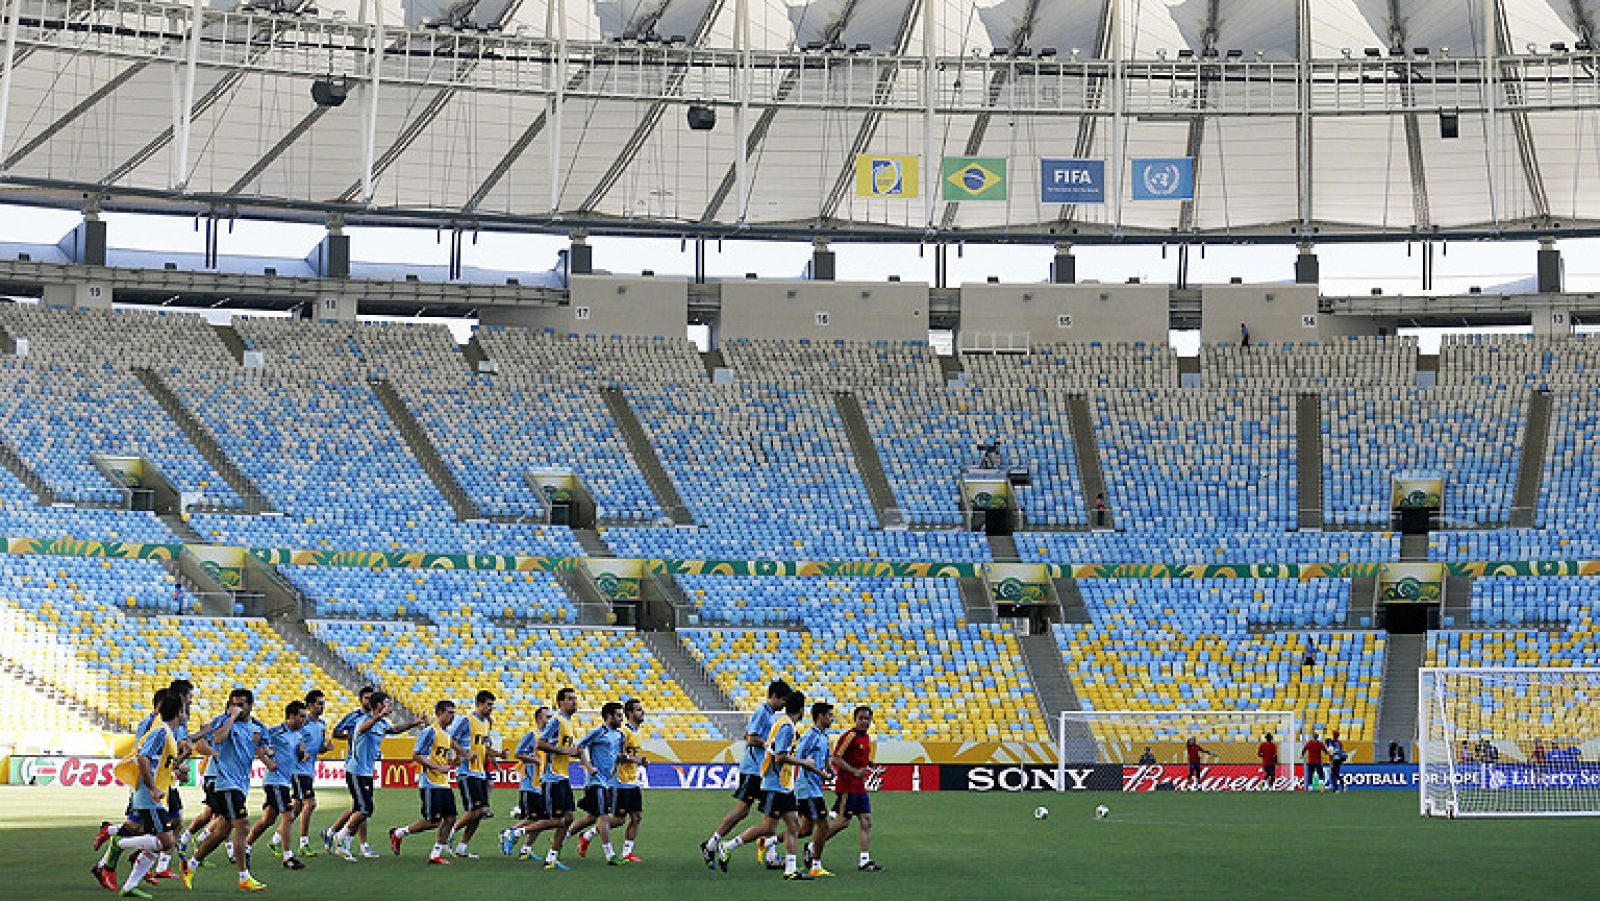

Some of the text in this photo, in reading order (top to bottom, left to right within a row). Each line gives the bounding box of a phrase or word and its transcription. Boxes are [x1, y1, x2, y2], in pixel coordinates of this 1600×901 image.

[1053, 169, 1093, 184] FIFA
[88, 287, 101, 297] 19
[576, 308, 589, 318] 17
[1059, 316, 1072, 326] 15
[1303, 316, 1316, 326] 14
[1552, 314, 1564, 324] 13
[673, 765, 740, 788] VISA
[967, 767, 1094, 791] SONY
